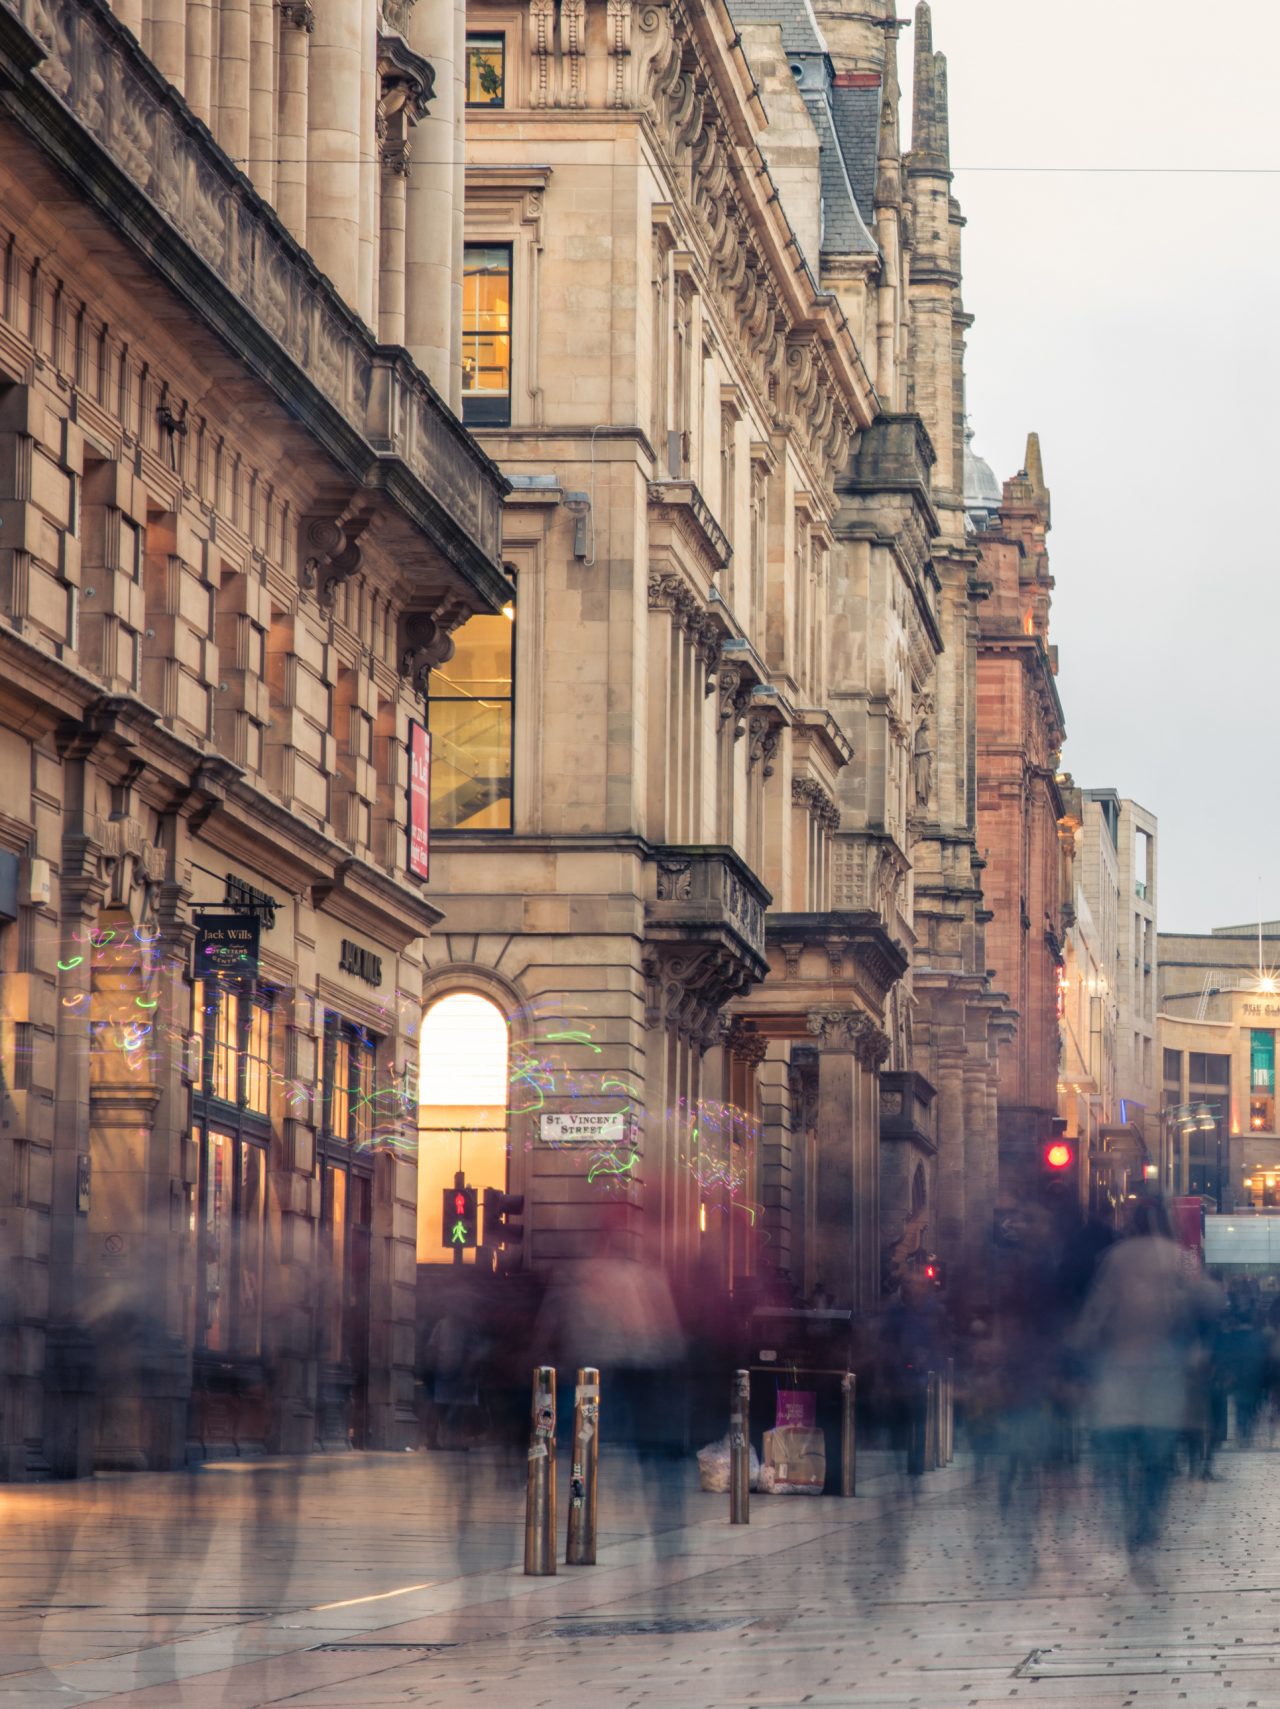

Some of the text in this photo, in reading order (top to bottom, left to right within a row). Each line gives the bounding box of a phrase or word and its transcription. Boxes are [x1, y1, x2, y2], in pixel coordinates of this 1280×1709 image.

[203, 929, 253, 942] Jack Wills
[569, 1115, 618, 1124] VINCENT
[560, 1125, 604, 1134] STREET
